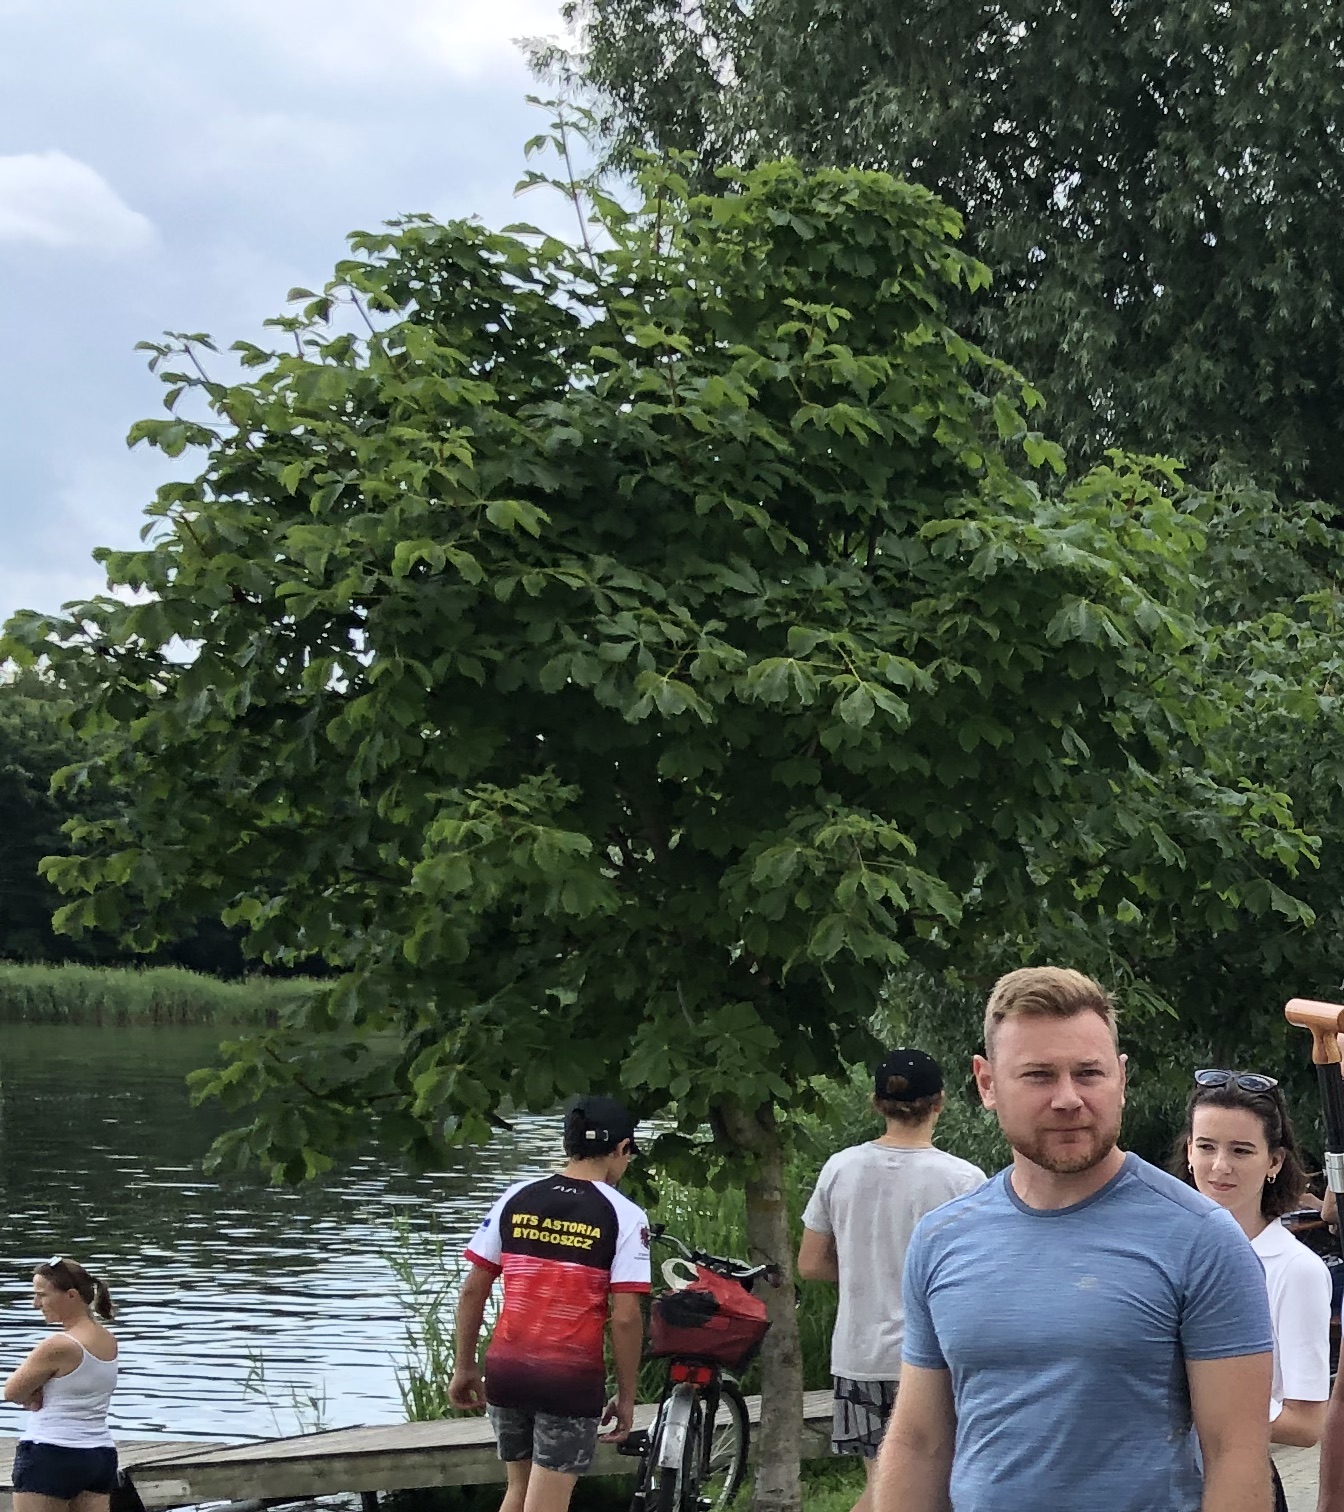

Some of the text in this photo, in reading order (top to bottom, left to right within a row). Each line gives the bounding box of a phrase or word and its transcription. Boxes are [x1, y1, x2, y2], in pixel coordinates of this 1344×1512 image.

[511, 1213, 601, 1239] WTS ASTORIA
[512, 1227, 594, 1250] BYDGOSZCZ
